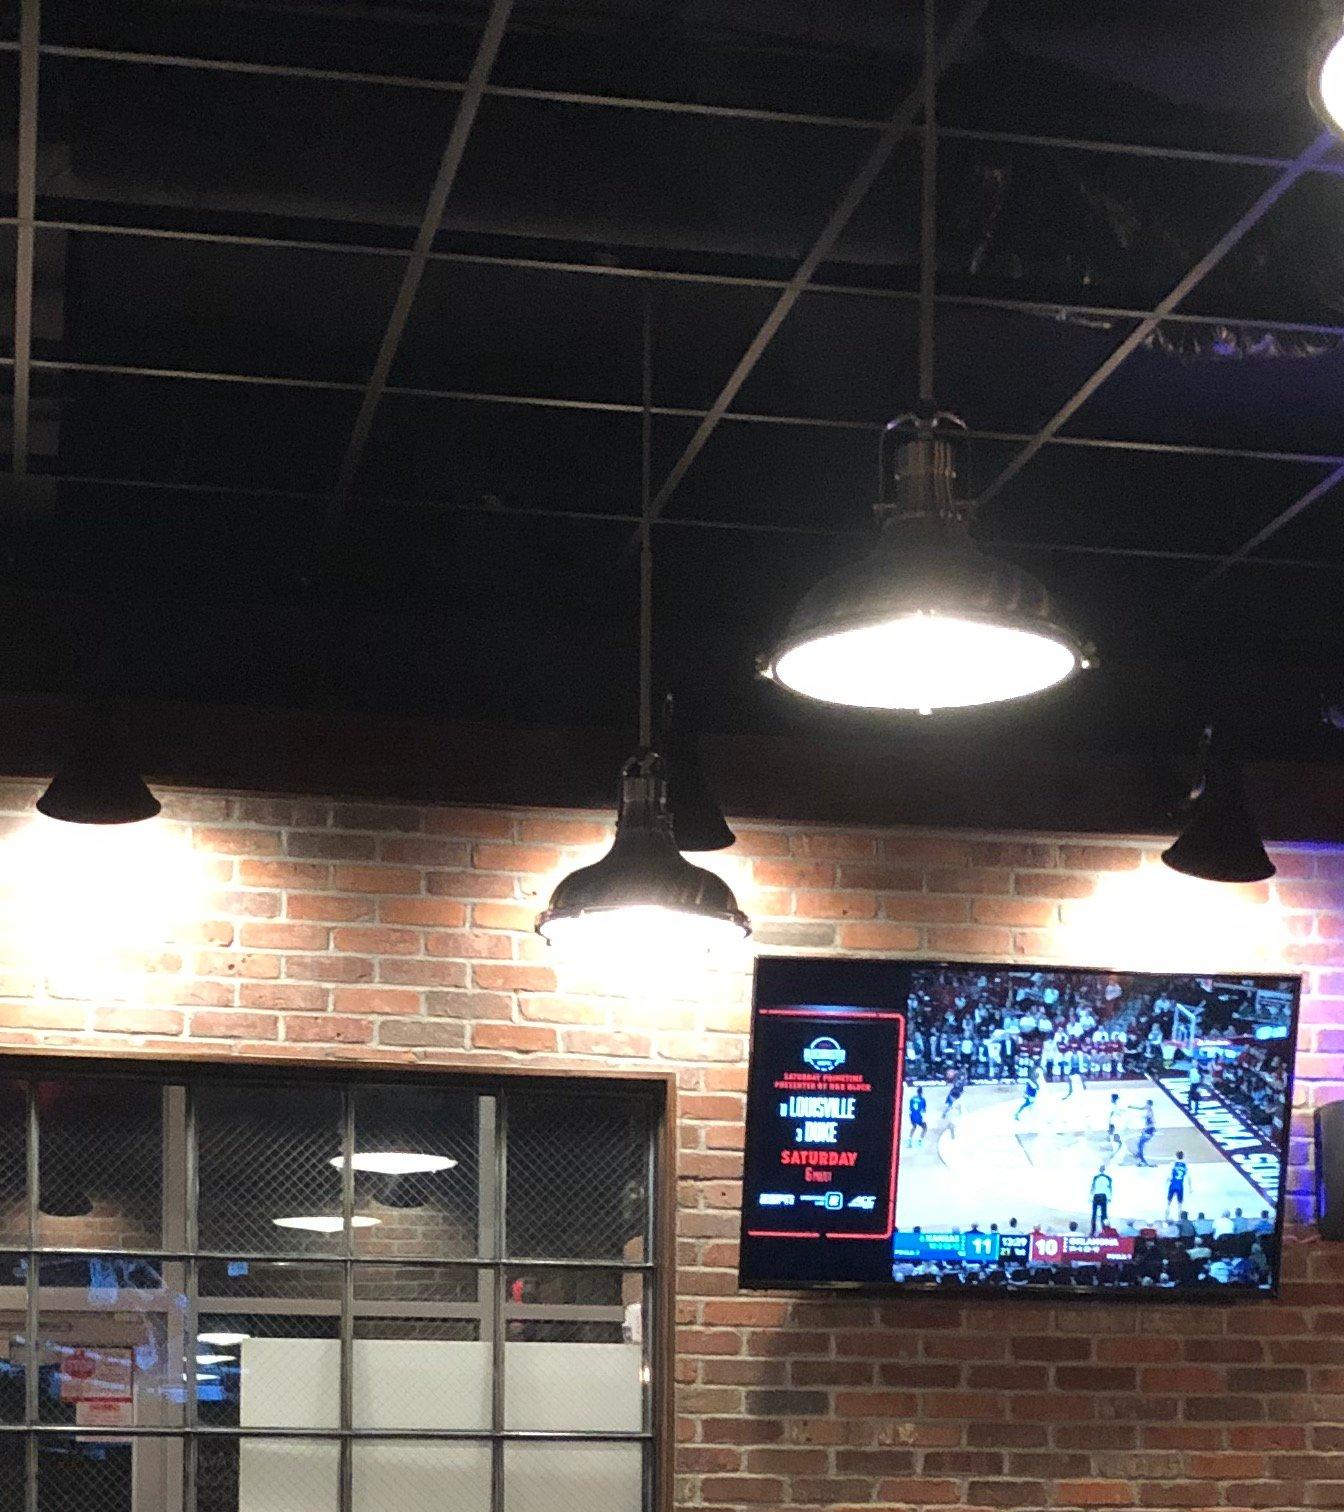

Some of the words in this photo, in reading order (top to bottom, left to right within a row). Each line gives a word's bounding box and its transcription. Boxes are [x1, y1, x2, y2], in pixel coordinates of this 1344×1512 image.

[789, 1095, 857, 1119] LOUISVILLE
[804, 1121, 838, 1143] DUKE
[780, 1150, 858, 1166] SATURDAY
[972, 1238, 992, 1255] 11
[1035, 1238, 1059, 1256] 10
